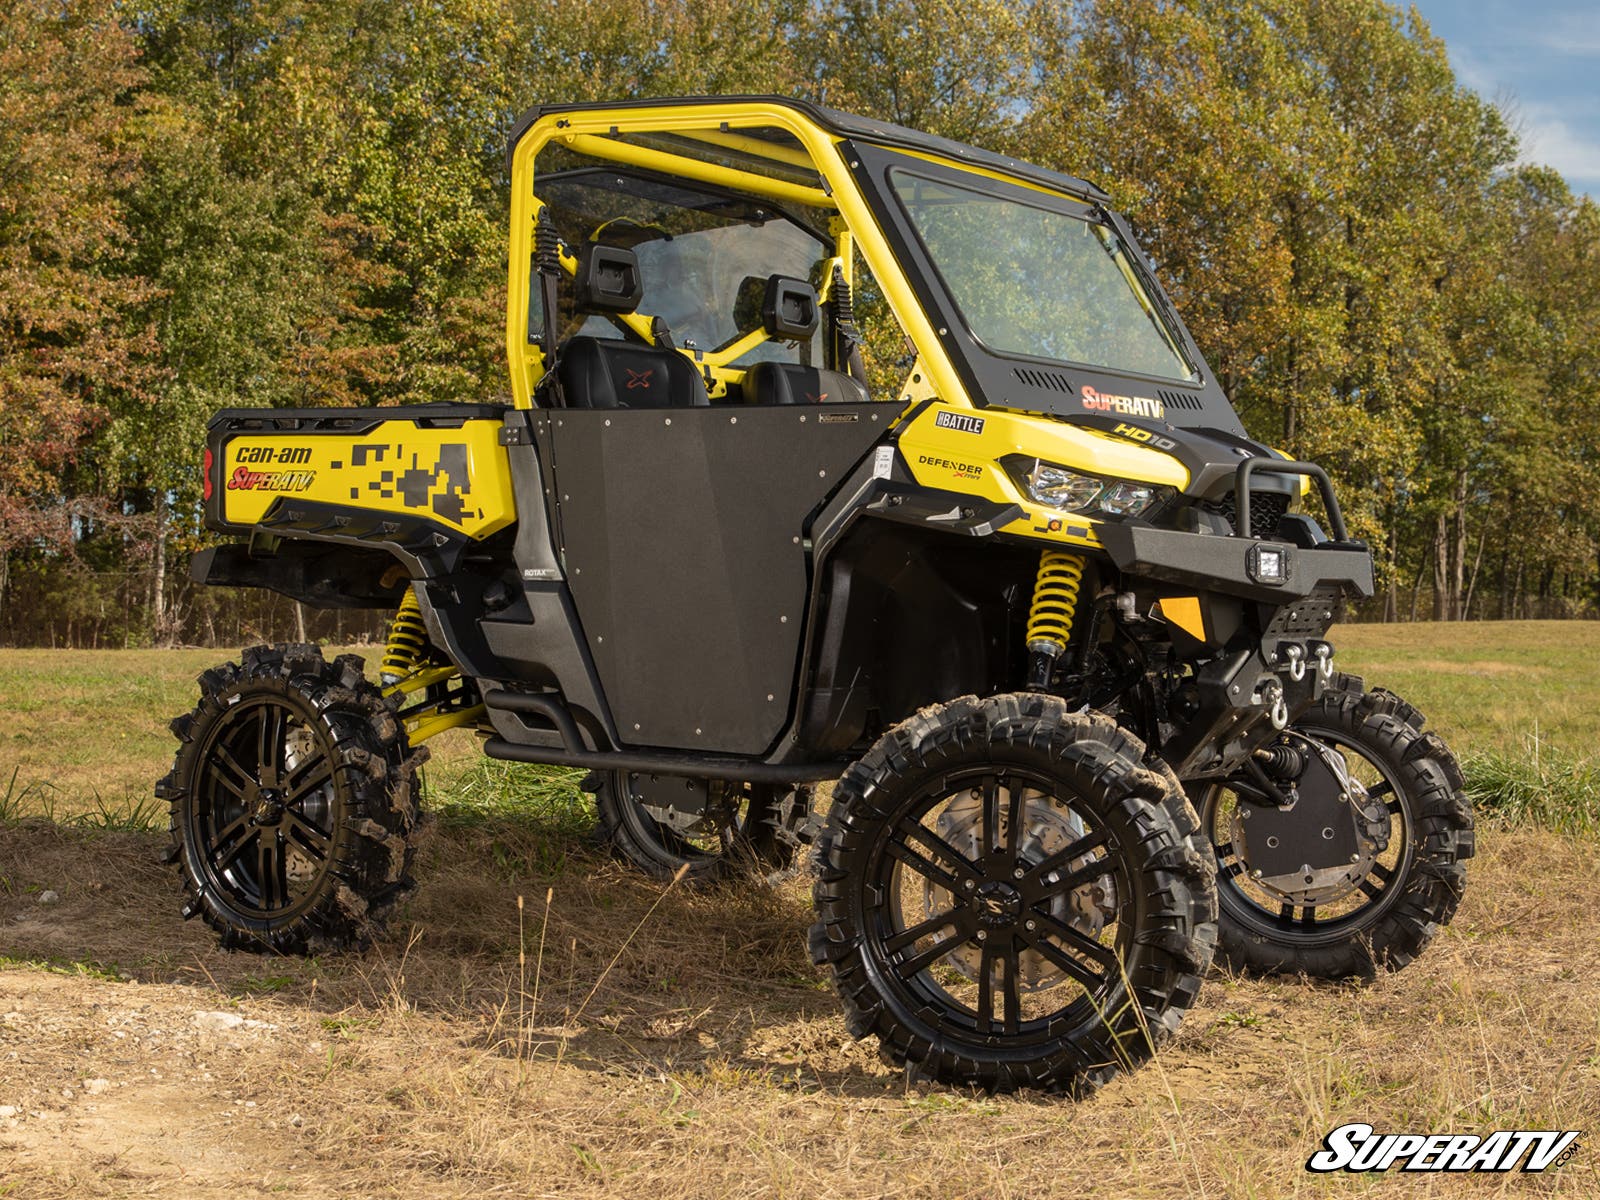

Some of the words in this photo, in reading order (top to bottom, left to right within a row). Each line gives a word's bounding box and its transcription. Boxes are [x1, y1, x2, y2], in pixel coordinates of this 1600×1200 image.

[1081, 385, 1160, 419] SUPERATV
[942, 413, 984, 433] BATTLE
[1113, 423, 1176, 451] HD10
[235, 447, 313, 464] can-am
[918, 455, 983, 475] DEFENDER
[228, 466, 315, 491] SUPERATV
[524, 568, 546, 577] ROTAX
